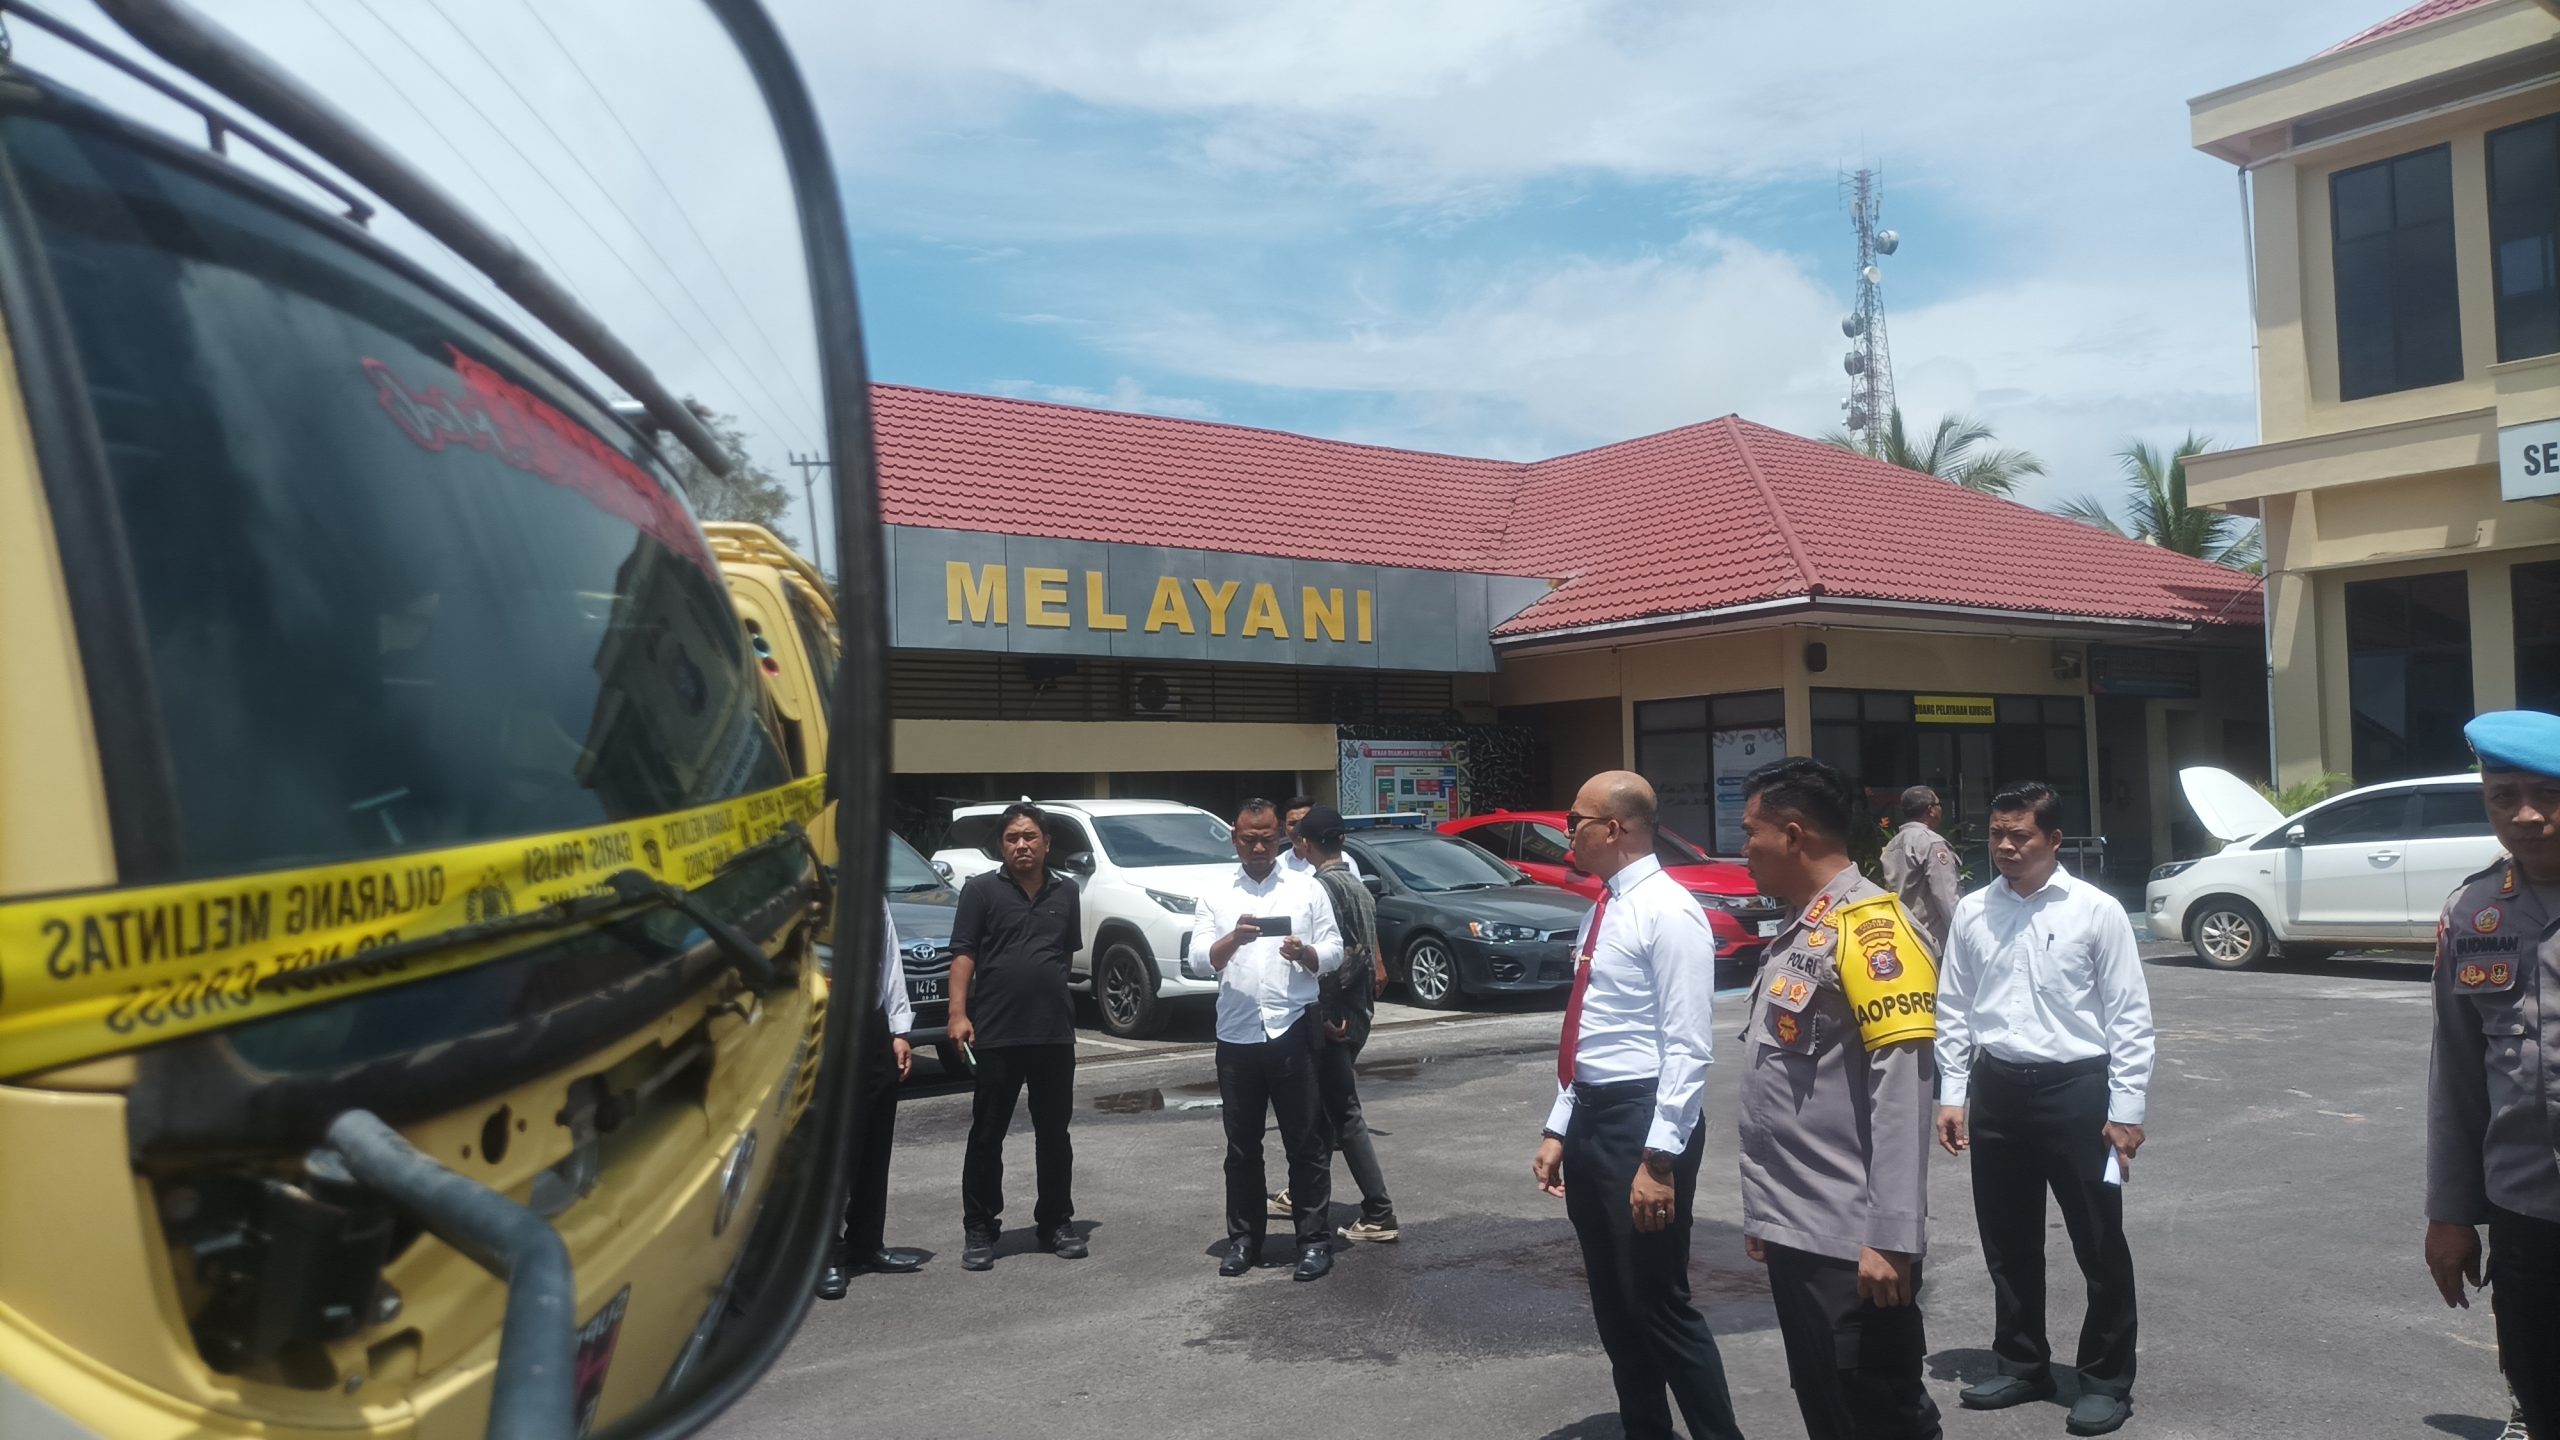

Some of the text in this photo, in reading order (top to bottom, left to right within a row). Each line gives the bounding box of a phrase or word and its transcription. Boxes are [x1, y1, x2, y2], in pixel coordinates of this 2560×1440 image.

[946, 561, 1372, 642] MELAYANI
[2456, 936, 2519, 954] BUDIMAN
[1787, 952, 1818, 975] POLRI
[915, 979, 938, 995] 1475
